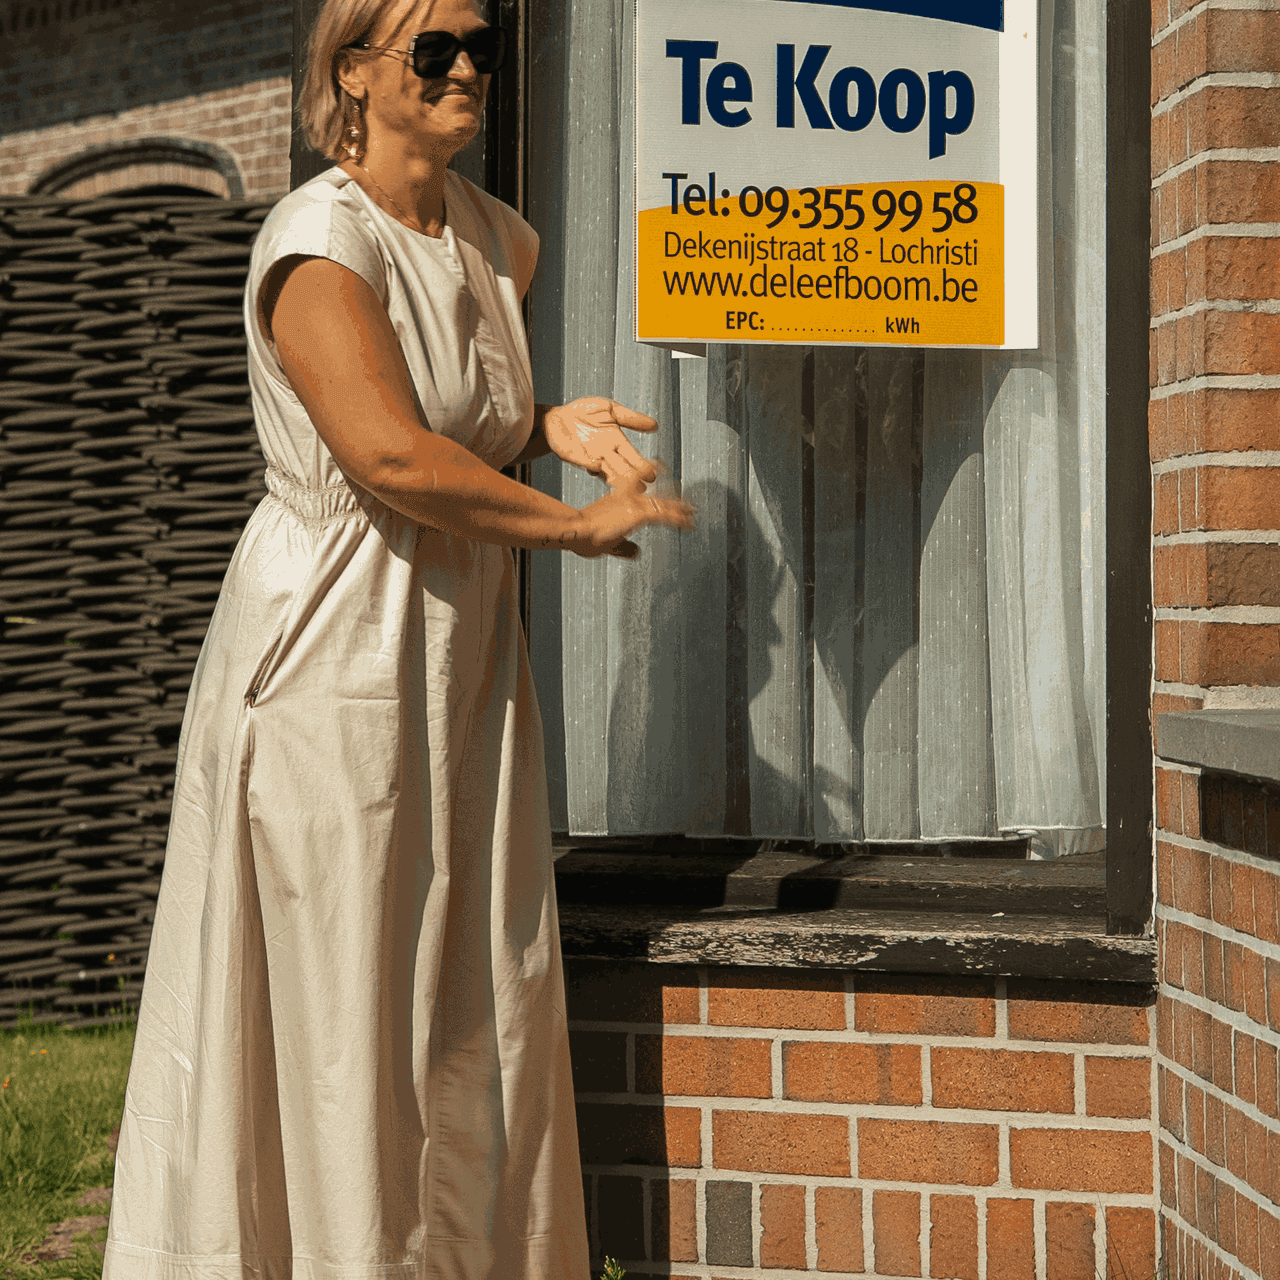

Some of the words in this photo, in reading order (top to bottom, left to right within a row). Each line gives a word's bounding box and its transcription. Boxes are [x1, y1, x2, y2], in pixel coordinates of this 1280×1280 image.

[665, 39, 753, 128] Te
[776, 43, 976, 160] Koop
[662, 172, 730, 217] Tel:
[738, 185, 865, 230] 09.355
[872, 189, 923, 233] 99
[932, 183, 978, 233] 58
[664, 231, 826, 266] Dekenijstraat
[833, 237, 859, 262] 18
[880, 237, 978, 266] Lochristi
[663, 263, 978, 303] www.deleefboom.be
[726, 311, 765, 330] EPC:
[885, 317, 920, 334] kWh
